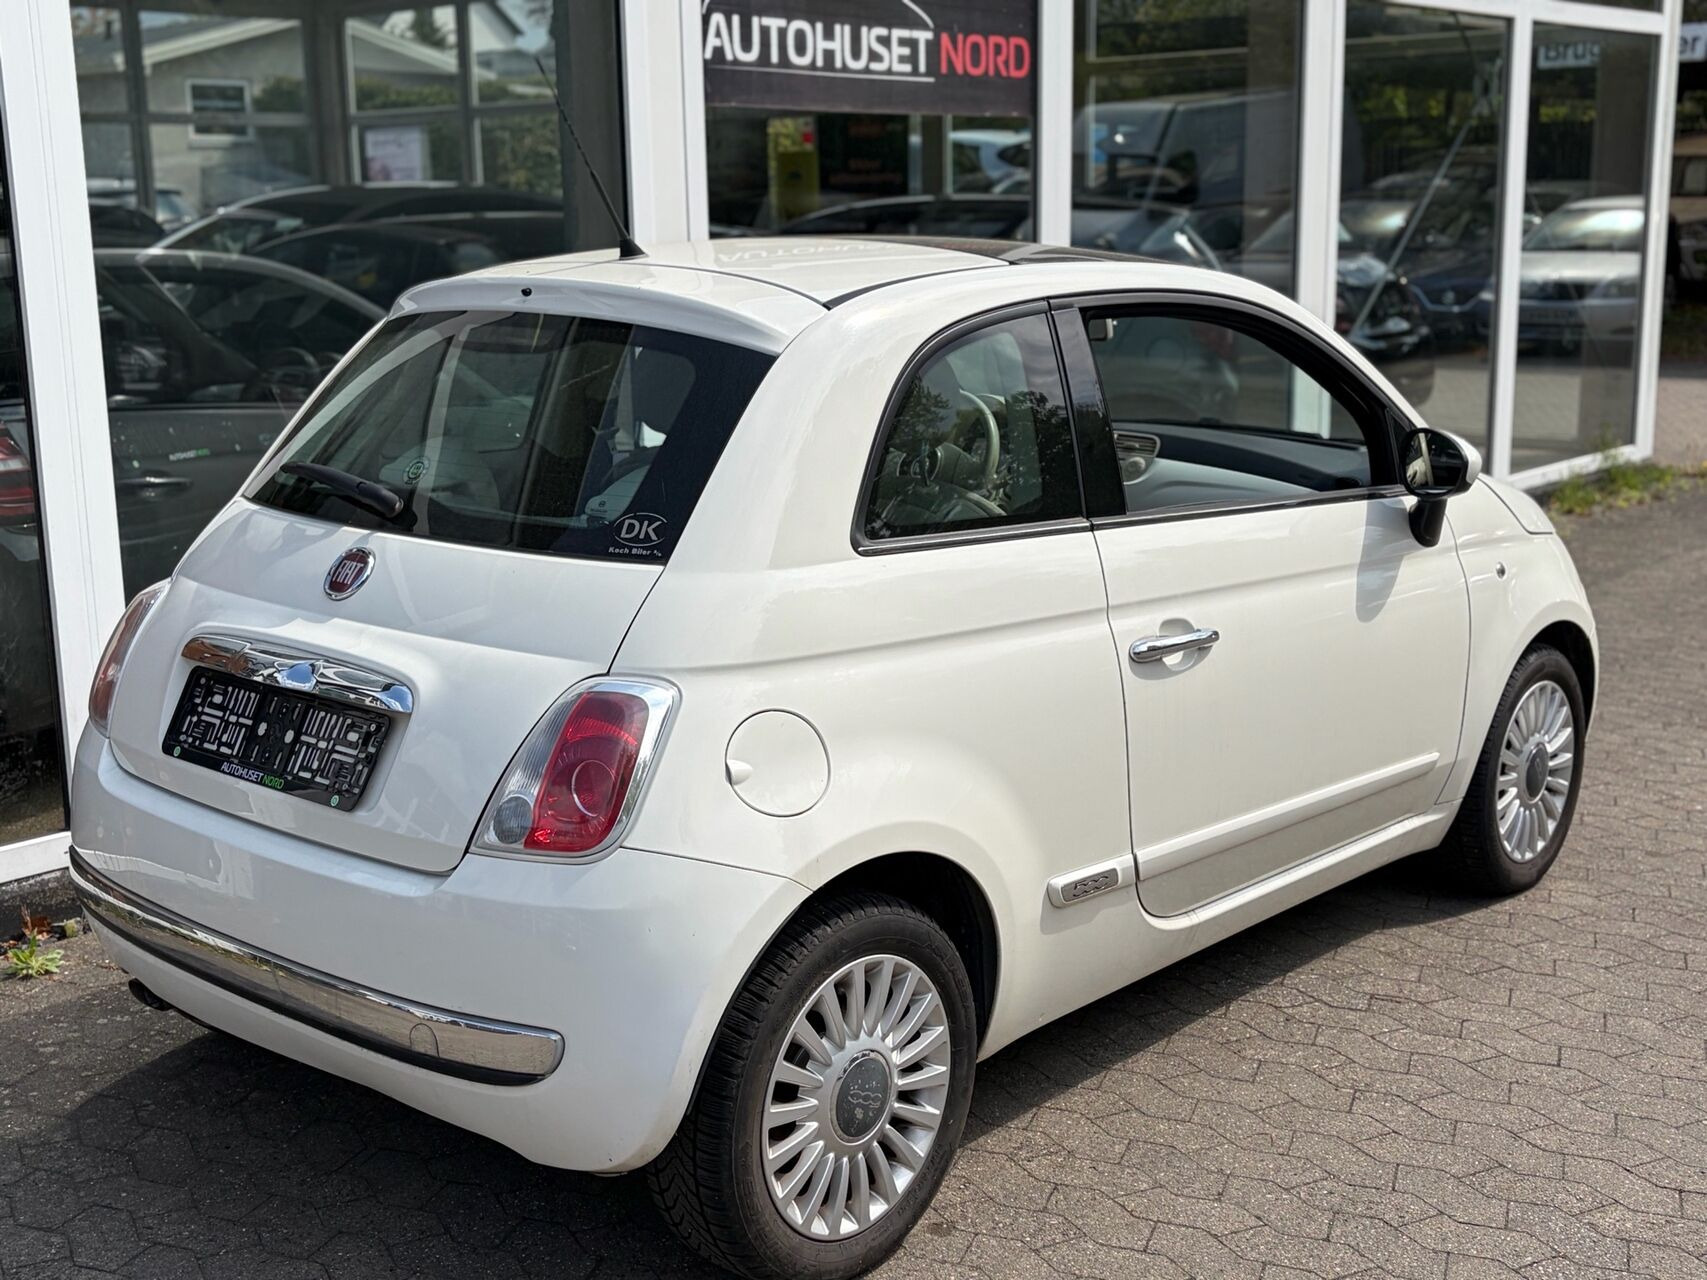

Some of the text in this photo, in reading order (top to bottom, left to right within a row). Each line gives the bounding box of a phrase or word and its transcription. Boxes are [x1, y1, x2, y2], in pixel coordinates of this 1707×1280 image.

[704, 12, 1030, 78] AUTOHUSET NORD
[620, 518, 662, 540] DK
[332, 559, 364, 585] FIAT
[220, 761, 284, 790] AUTOHUSET NORD
